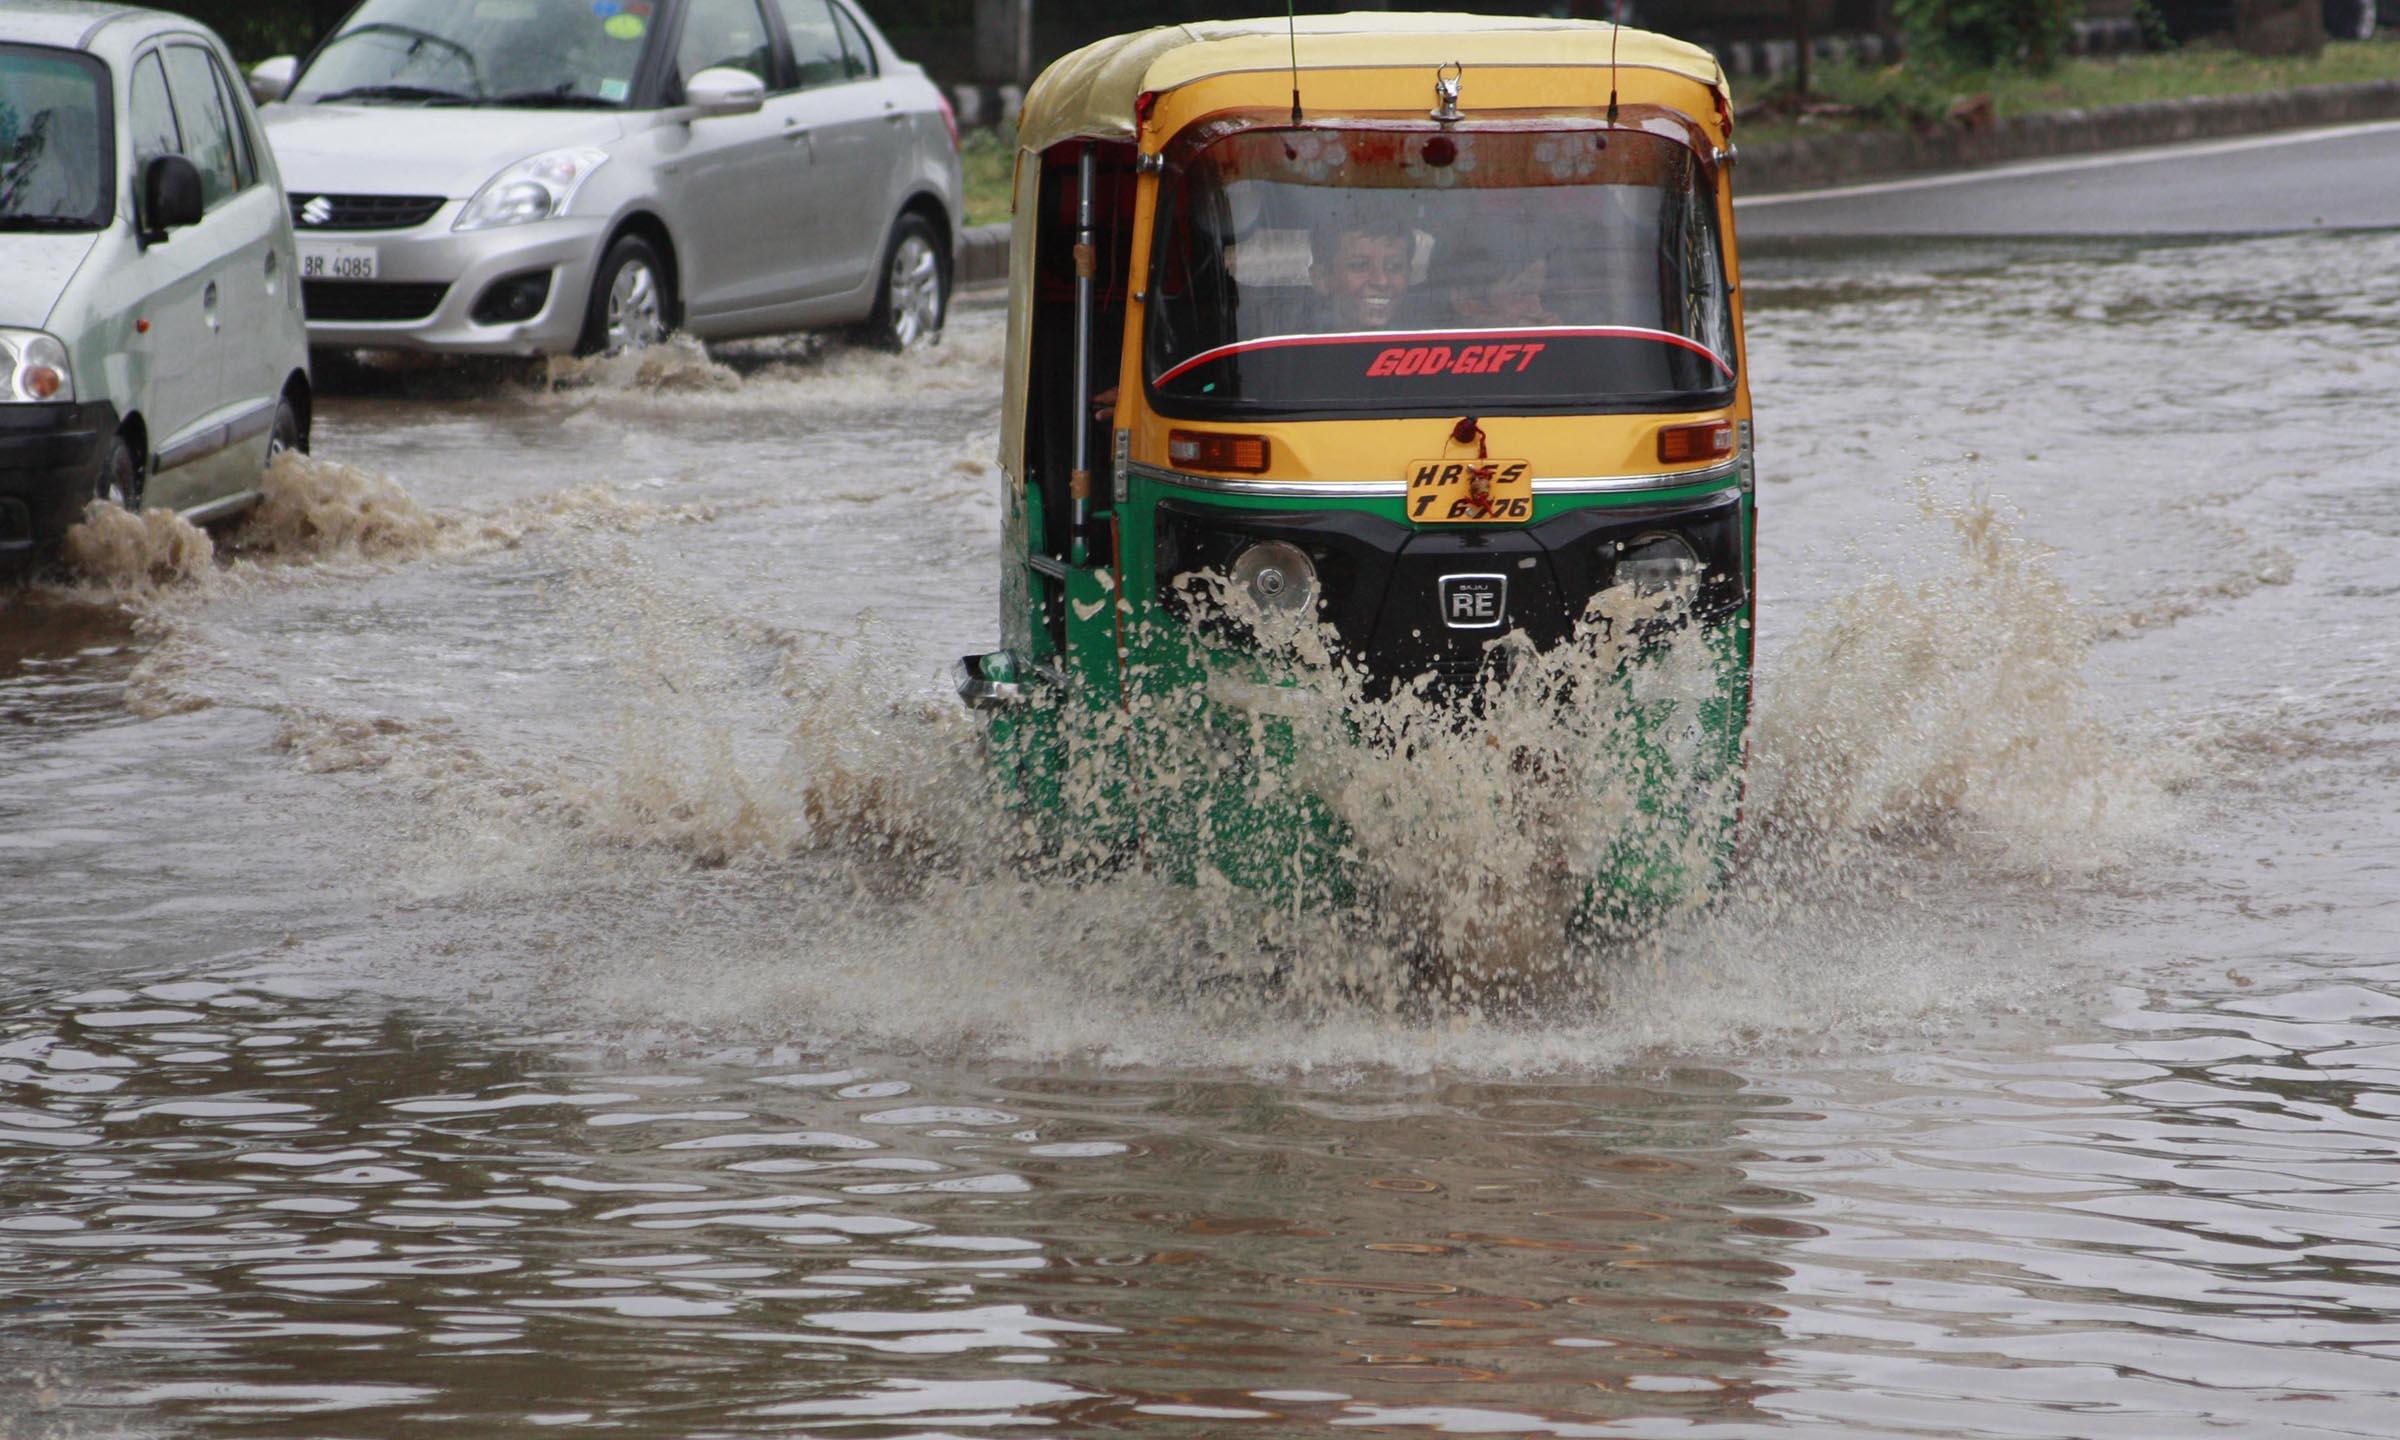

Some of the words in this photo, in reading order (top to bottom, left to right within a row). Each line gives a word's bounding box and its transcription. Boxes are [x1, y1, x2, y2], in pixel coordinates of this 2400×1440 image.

[333, 257, 371, 276] 4085
[1413, 464, 1463, 488] HR
[1413, 495, 1438, 517] T
[1453, 593, 1494, 617] RE
